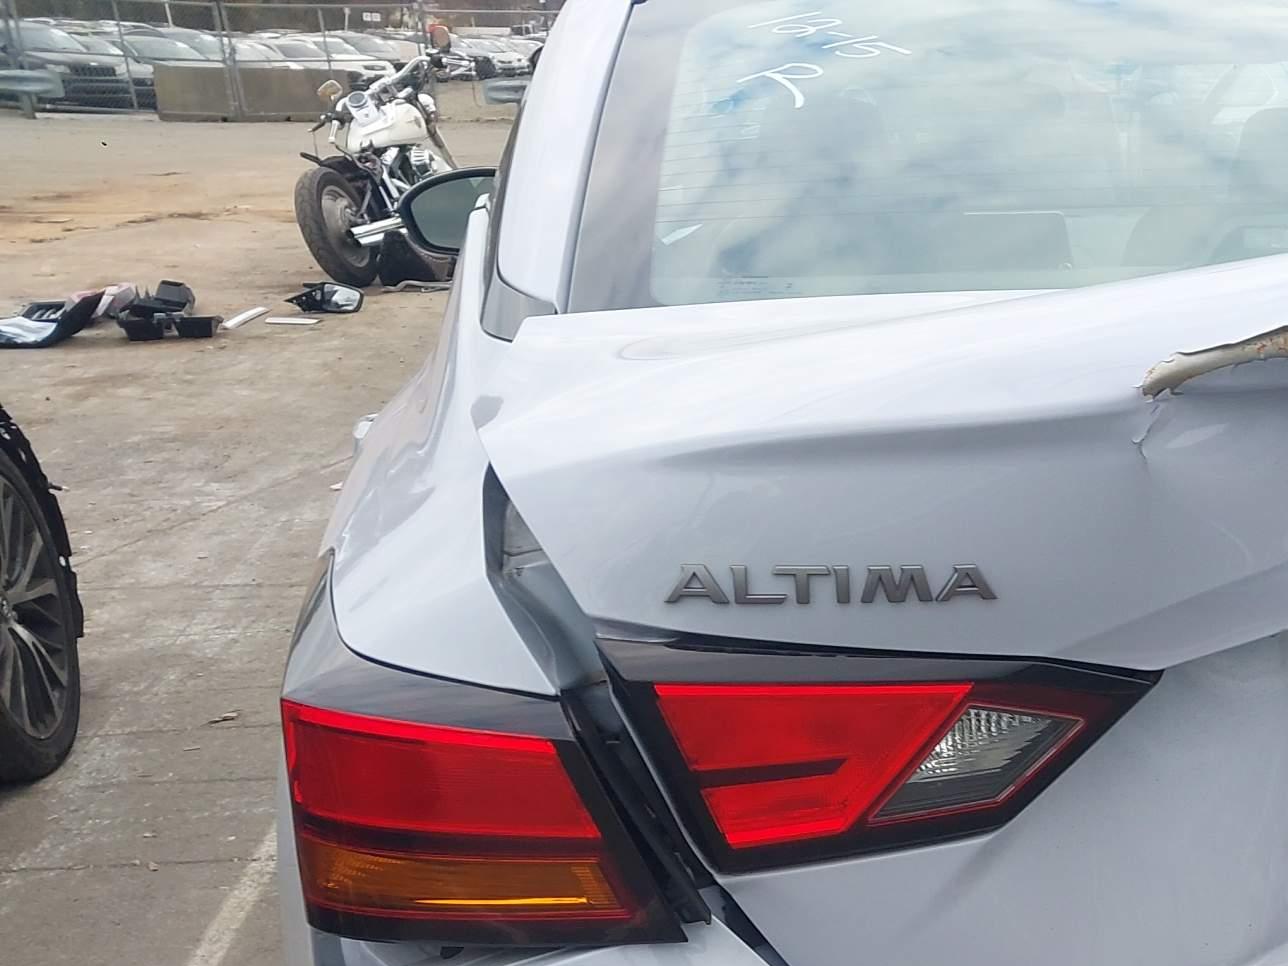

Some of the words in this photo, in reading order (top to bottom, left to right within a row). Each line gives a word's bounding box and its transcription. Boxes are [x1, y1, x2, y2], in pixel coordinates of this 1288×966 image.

[747, 11, 912, 58] 12-15
[736, 62, 824, 108] R
[663, 563, 999, 604] ALTIMA
